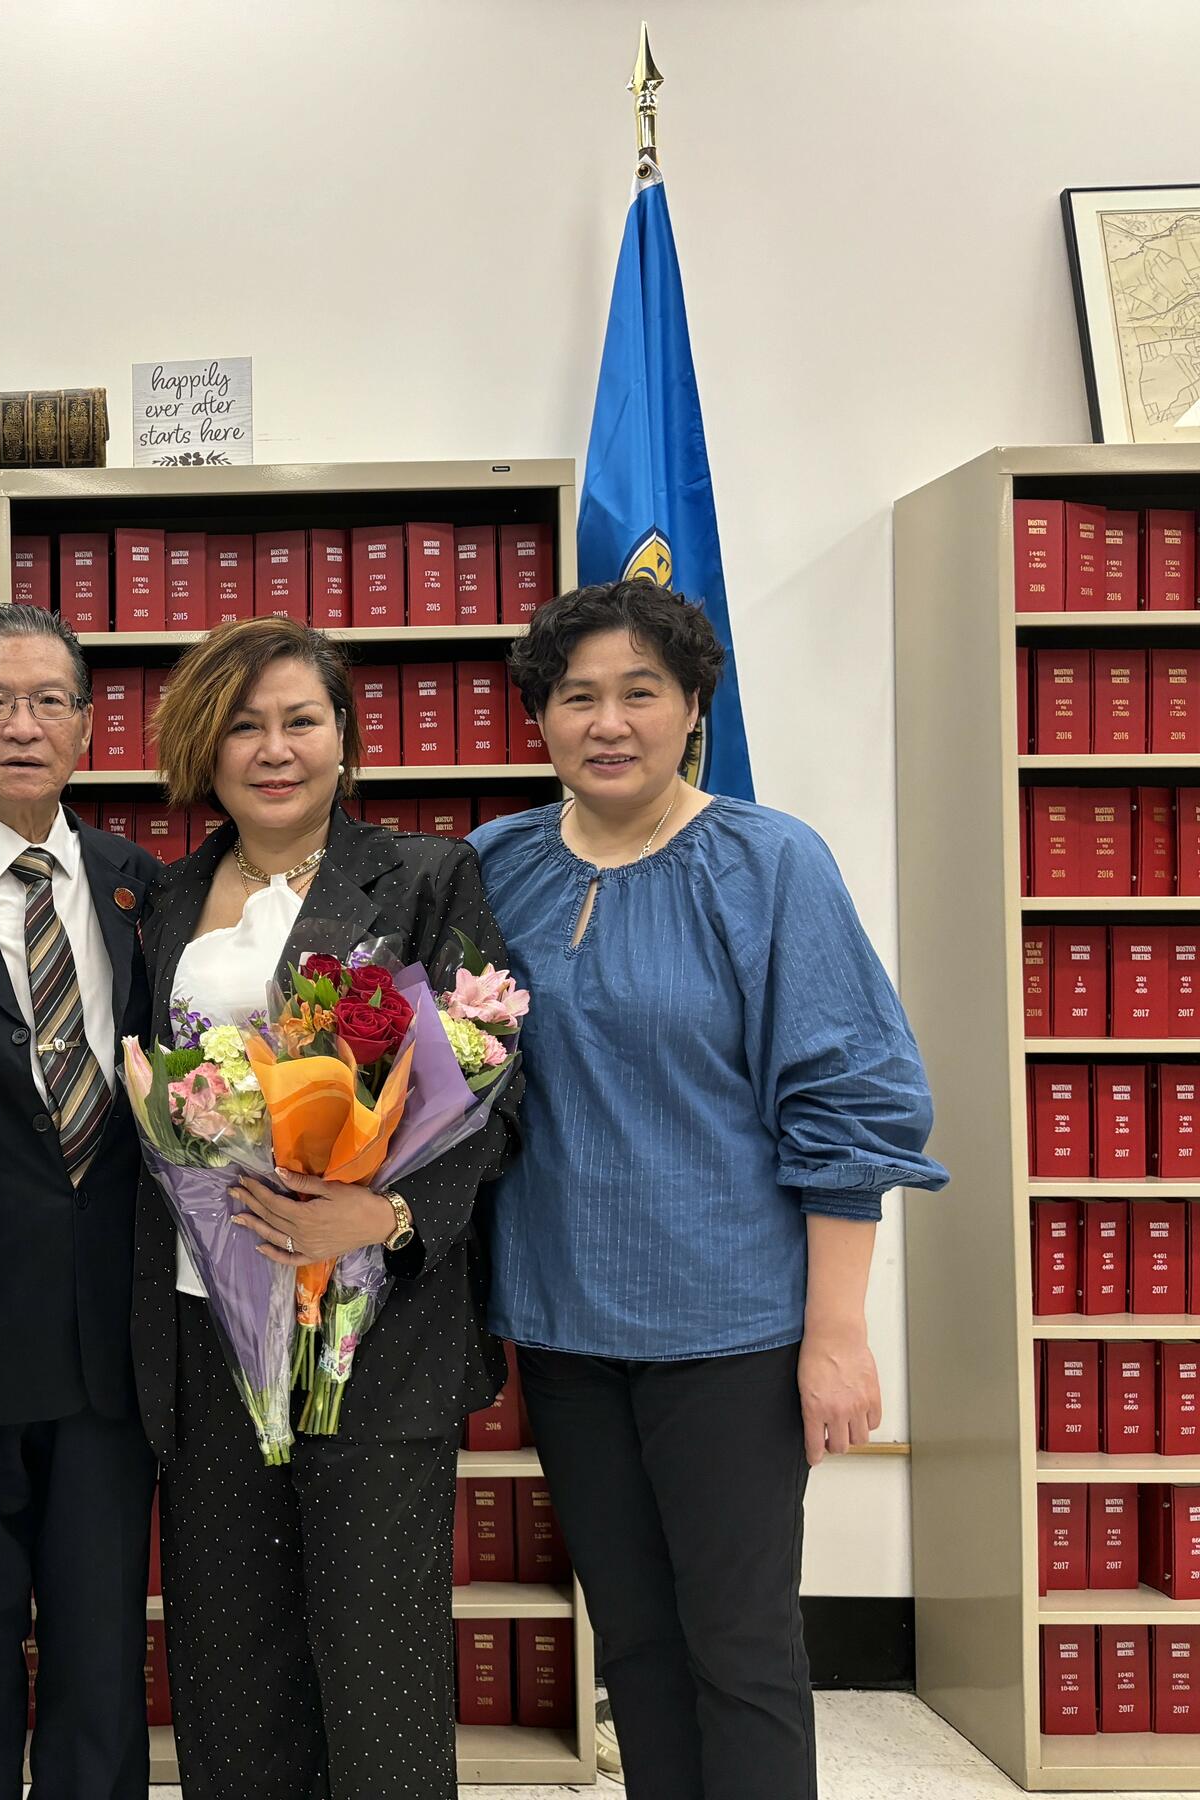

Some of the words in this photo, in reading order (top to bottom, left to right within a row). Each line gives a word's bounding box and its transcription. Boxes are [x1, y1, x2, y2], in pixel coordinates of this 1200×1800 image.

[152, 361, 231, 400] happily
[145, 402, 183, 418] ever
[191, 389, 236, 416] after
[140, 423, 191, 446] starts
[200, 417, 245, 442] here
[1027, 518, 1048, 526] BOSTON
[367, 543, 387, 551] BOSTON
[457, 543, 477, 551] BOSTON
[368, 552, 387, 560] BIRTHS
[423, 548, 440, 556] BIRTHS
[458, 552, 477, 560] BIRTHS
[132, 554, 150, 562] BIRTHS
[1029, 583, 1046, 593] 2016
[370, 605, 387, 616] 2015
[425, 602, 441, 612] 2015
[460, 605, 477, 615] 2015
[133, 608, 149, 618] 2015
[364, 682, 384, 690] BOSTON
[417, 680, 437, 688] BOSTON
[365, 691, 383, 699] BIRTHS
[418, 689, 437, 697] BIRTHS
[366, 744, 383, 756] 2015
[420, 742, 438, 752] 2015
[1070, 944, 1091, 952] BOSTON
[1071, 953, 1091, 961] BIRTHS
[1071, 1007, 1089, 1017] 2017
[1132, 1008, 1150, 1018] 2017
[1177, 1008, 1195, 1018] 2017
[1051, 1083, 1073, 1091] BOSTON
[1111, 1084, 1132, 1092] BOSTON
[1052, 1092, 1072, 1100] BIRTHS
[1112, 1093, 1131, 1101] BIRTHS
[1054, 1147, 1072, 1157] 2017
[1114, 1148, 1130, 1158] 2017
[1149, 1221, 1170, 1229] BOSTON
[1151, 1285, 1169, 1295] 2017
[1064, 1369, 1083, 1377] BIRTHS
[1065, 1423, 1083, 1433] 2017
[1118, 1704, 1135, 1713] 2017
